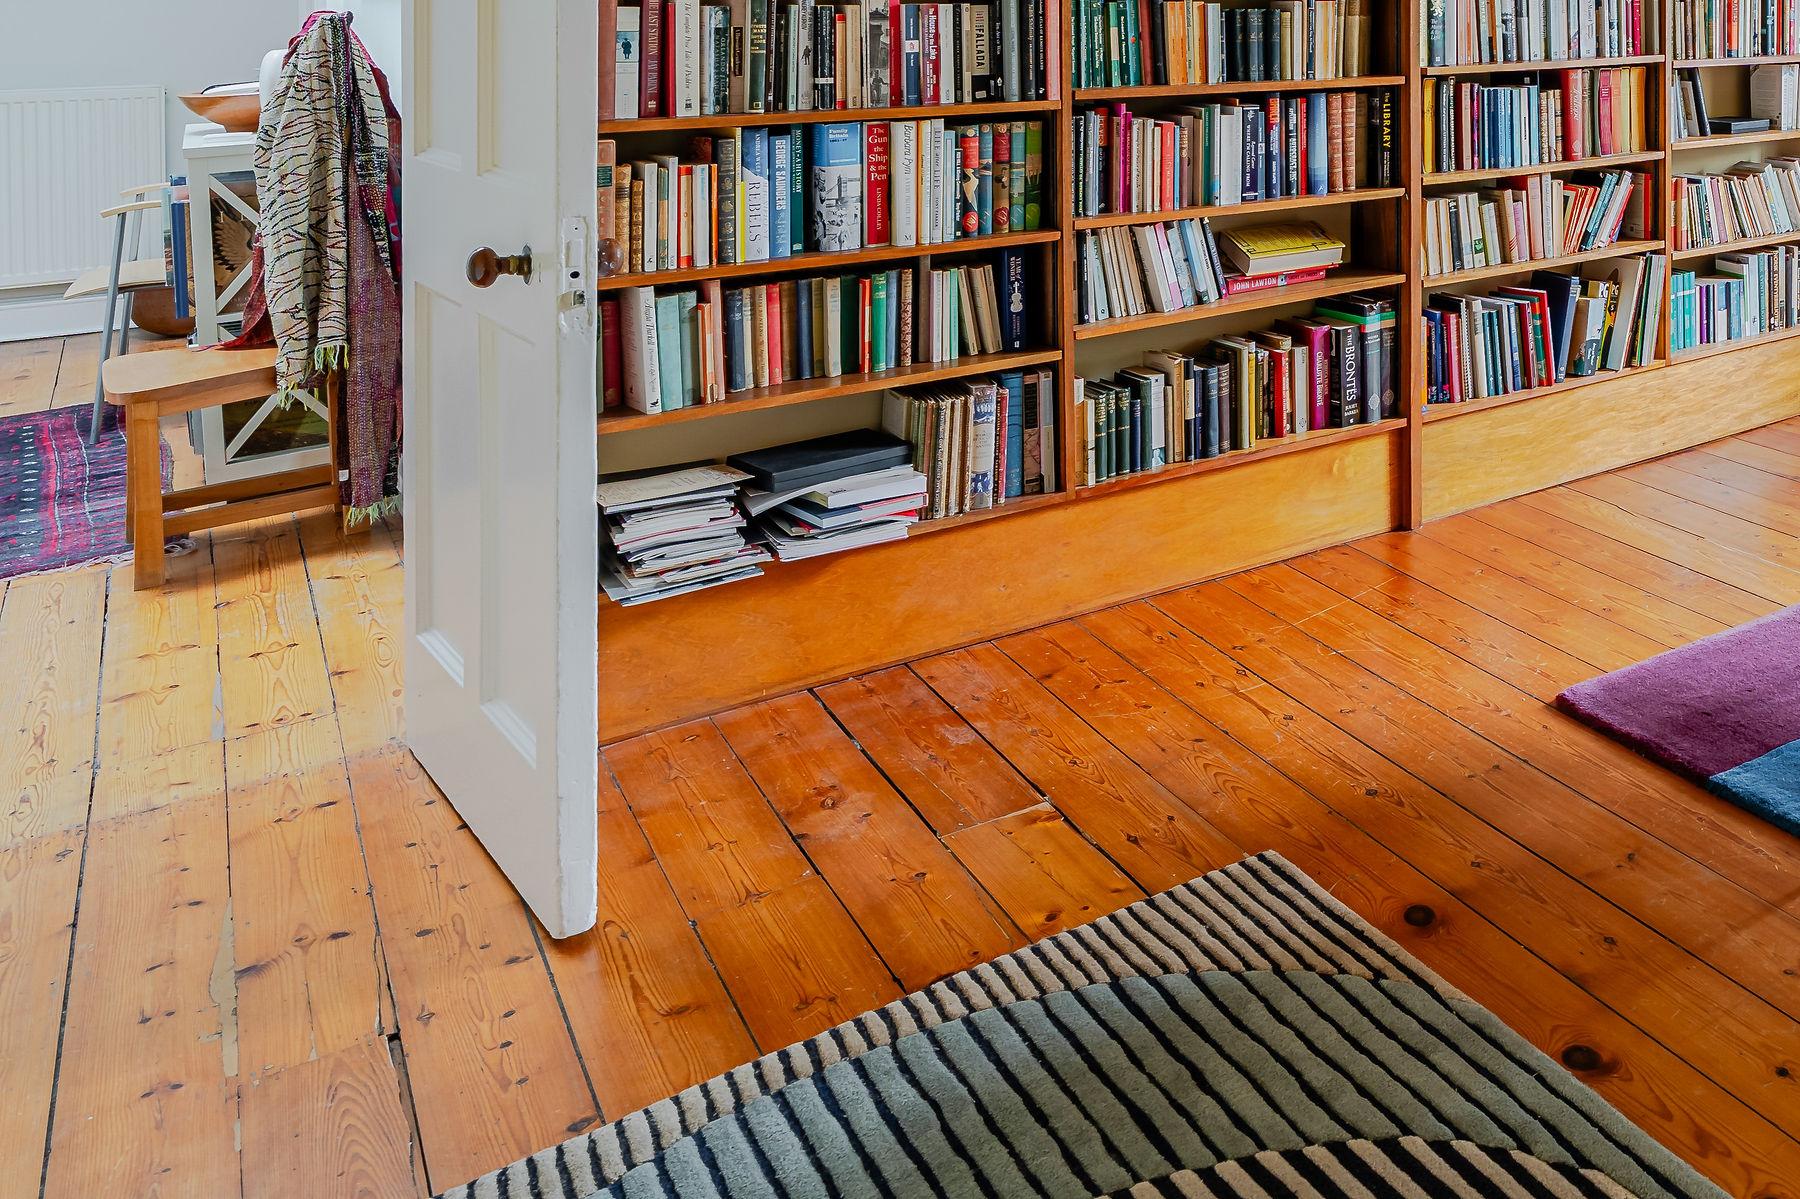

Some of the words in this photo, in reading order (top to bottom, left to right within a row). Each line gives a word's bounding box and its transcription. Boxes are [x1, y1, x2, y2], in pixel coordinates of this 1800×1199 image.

[648, 10, 658, 27] LAST
[929, 15, 937, 33] House
[648, 28, 658, 56] STATION
[929, 45, 937, 60] Lake
[975, 28, 985, 67] FALLADA
[648, 60, 658, 72] JAY
[648, 72, 658, 94] PARINI
[1383, 103, 1391, 148] LIBRARY
[868, 135, 888, 144] Gun
[903, 124, 914, 155] Barbara
[775, 139, 786, 169] GEORGE
[868, 154, 888, 163] Ship
[870, 173, 887, 181] Pen
[902, 157, 914, 175] Pym
[775, 171, 787, 211] SAUNDERS
[748, 181, 761, 242] REBELS
[1232, 280, 1250, 292] JOHN
[1251, 277, 1277, 288] LAWTON
[1316, 351, 1324, 384] CHARLOTTE
[1346, 346, 1357, 401] BRONTËS
